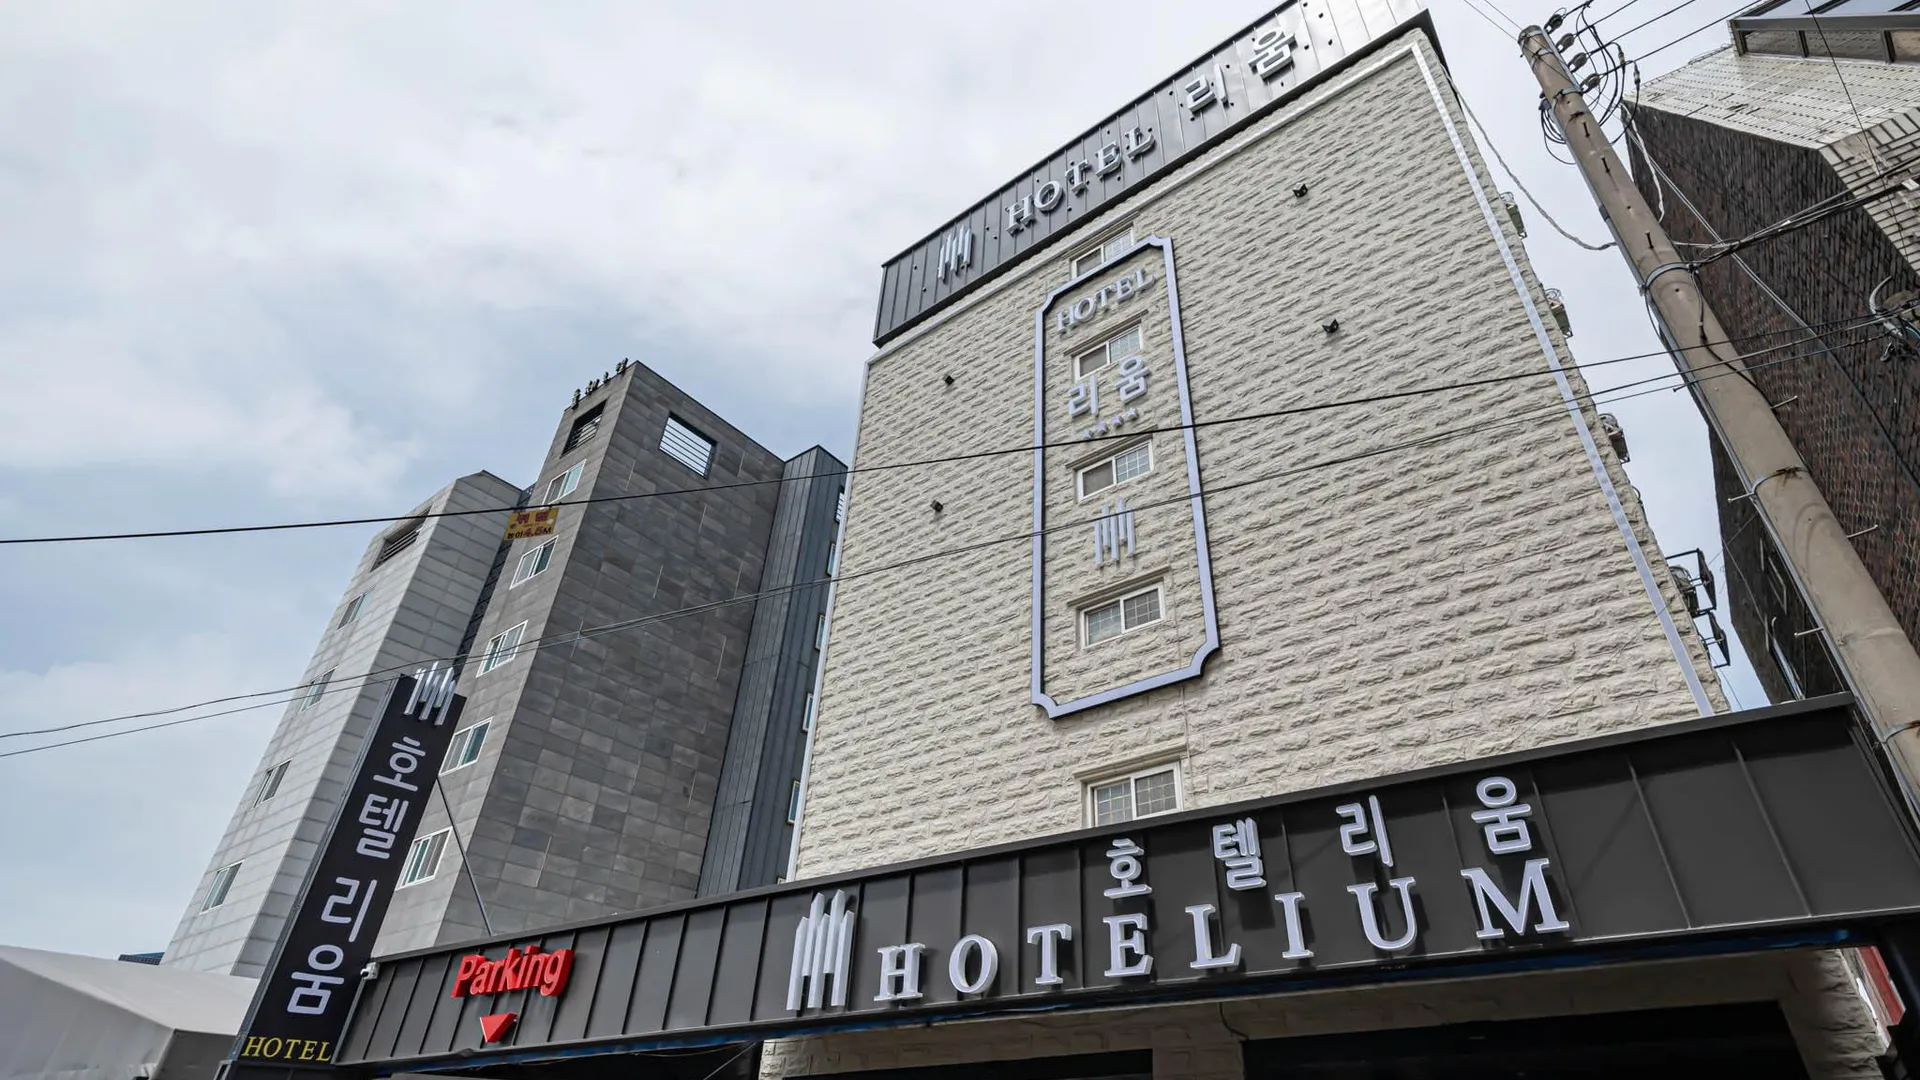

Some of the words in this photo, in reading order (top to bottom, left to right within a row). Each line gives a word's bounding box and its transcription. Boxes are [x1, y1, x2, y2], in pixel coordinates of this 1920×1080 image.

[1005, 125, 1156, 236] HOTEL
[1056, 267, 1156, 334] HOTEL
[873, 857, 1571, 1003] HOTELIUM
[450, 944, 575, 998] Parking
[240, 1036, 332, 1062] HOTEL
